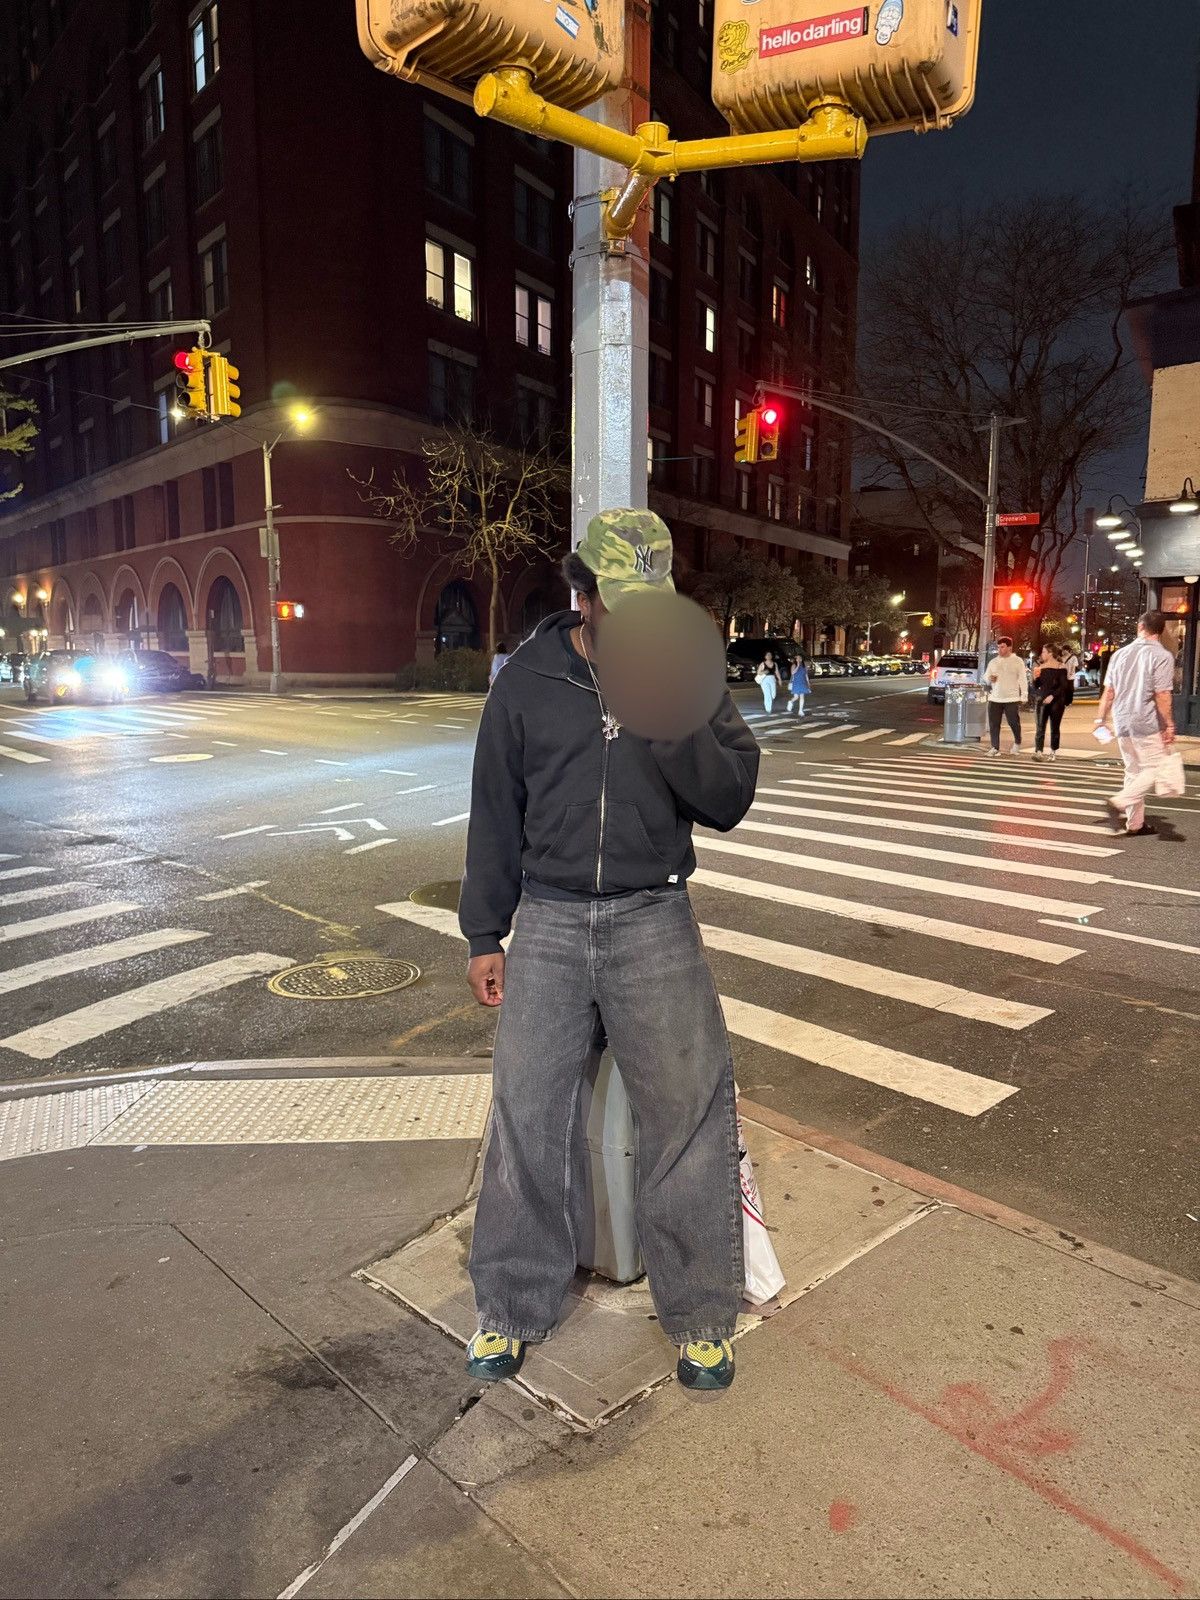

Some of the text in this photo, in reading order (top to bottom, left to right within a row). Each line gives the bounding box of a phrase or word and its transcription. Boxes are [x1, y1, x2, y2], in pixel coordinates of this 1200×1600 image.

[762, 29, 801, 50] hello
[802, 17, 862, 42] darling
[634, 545, 655, 573] NY
